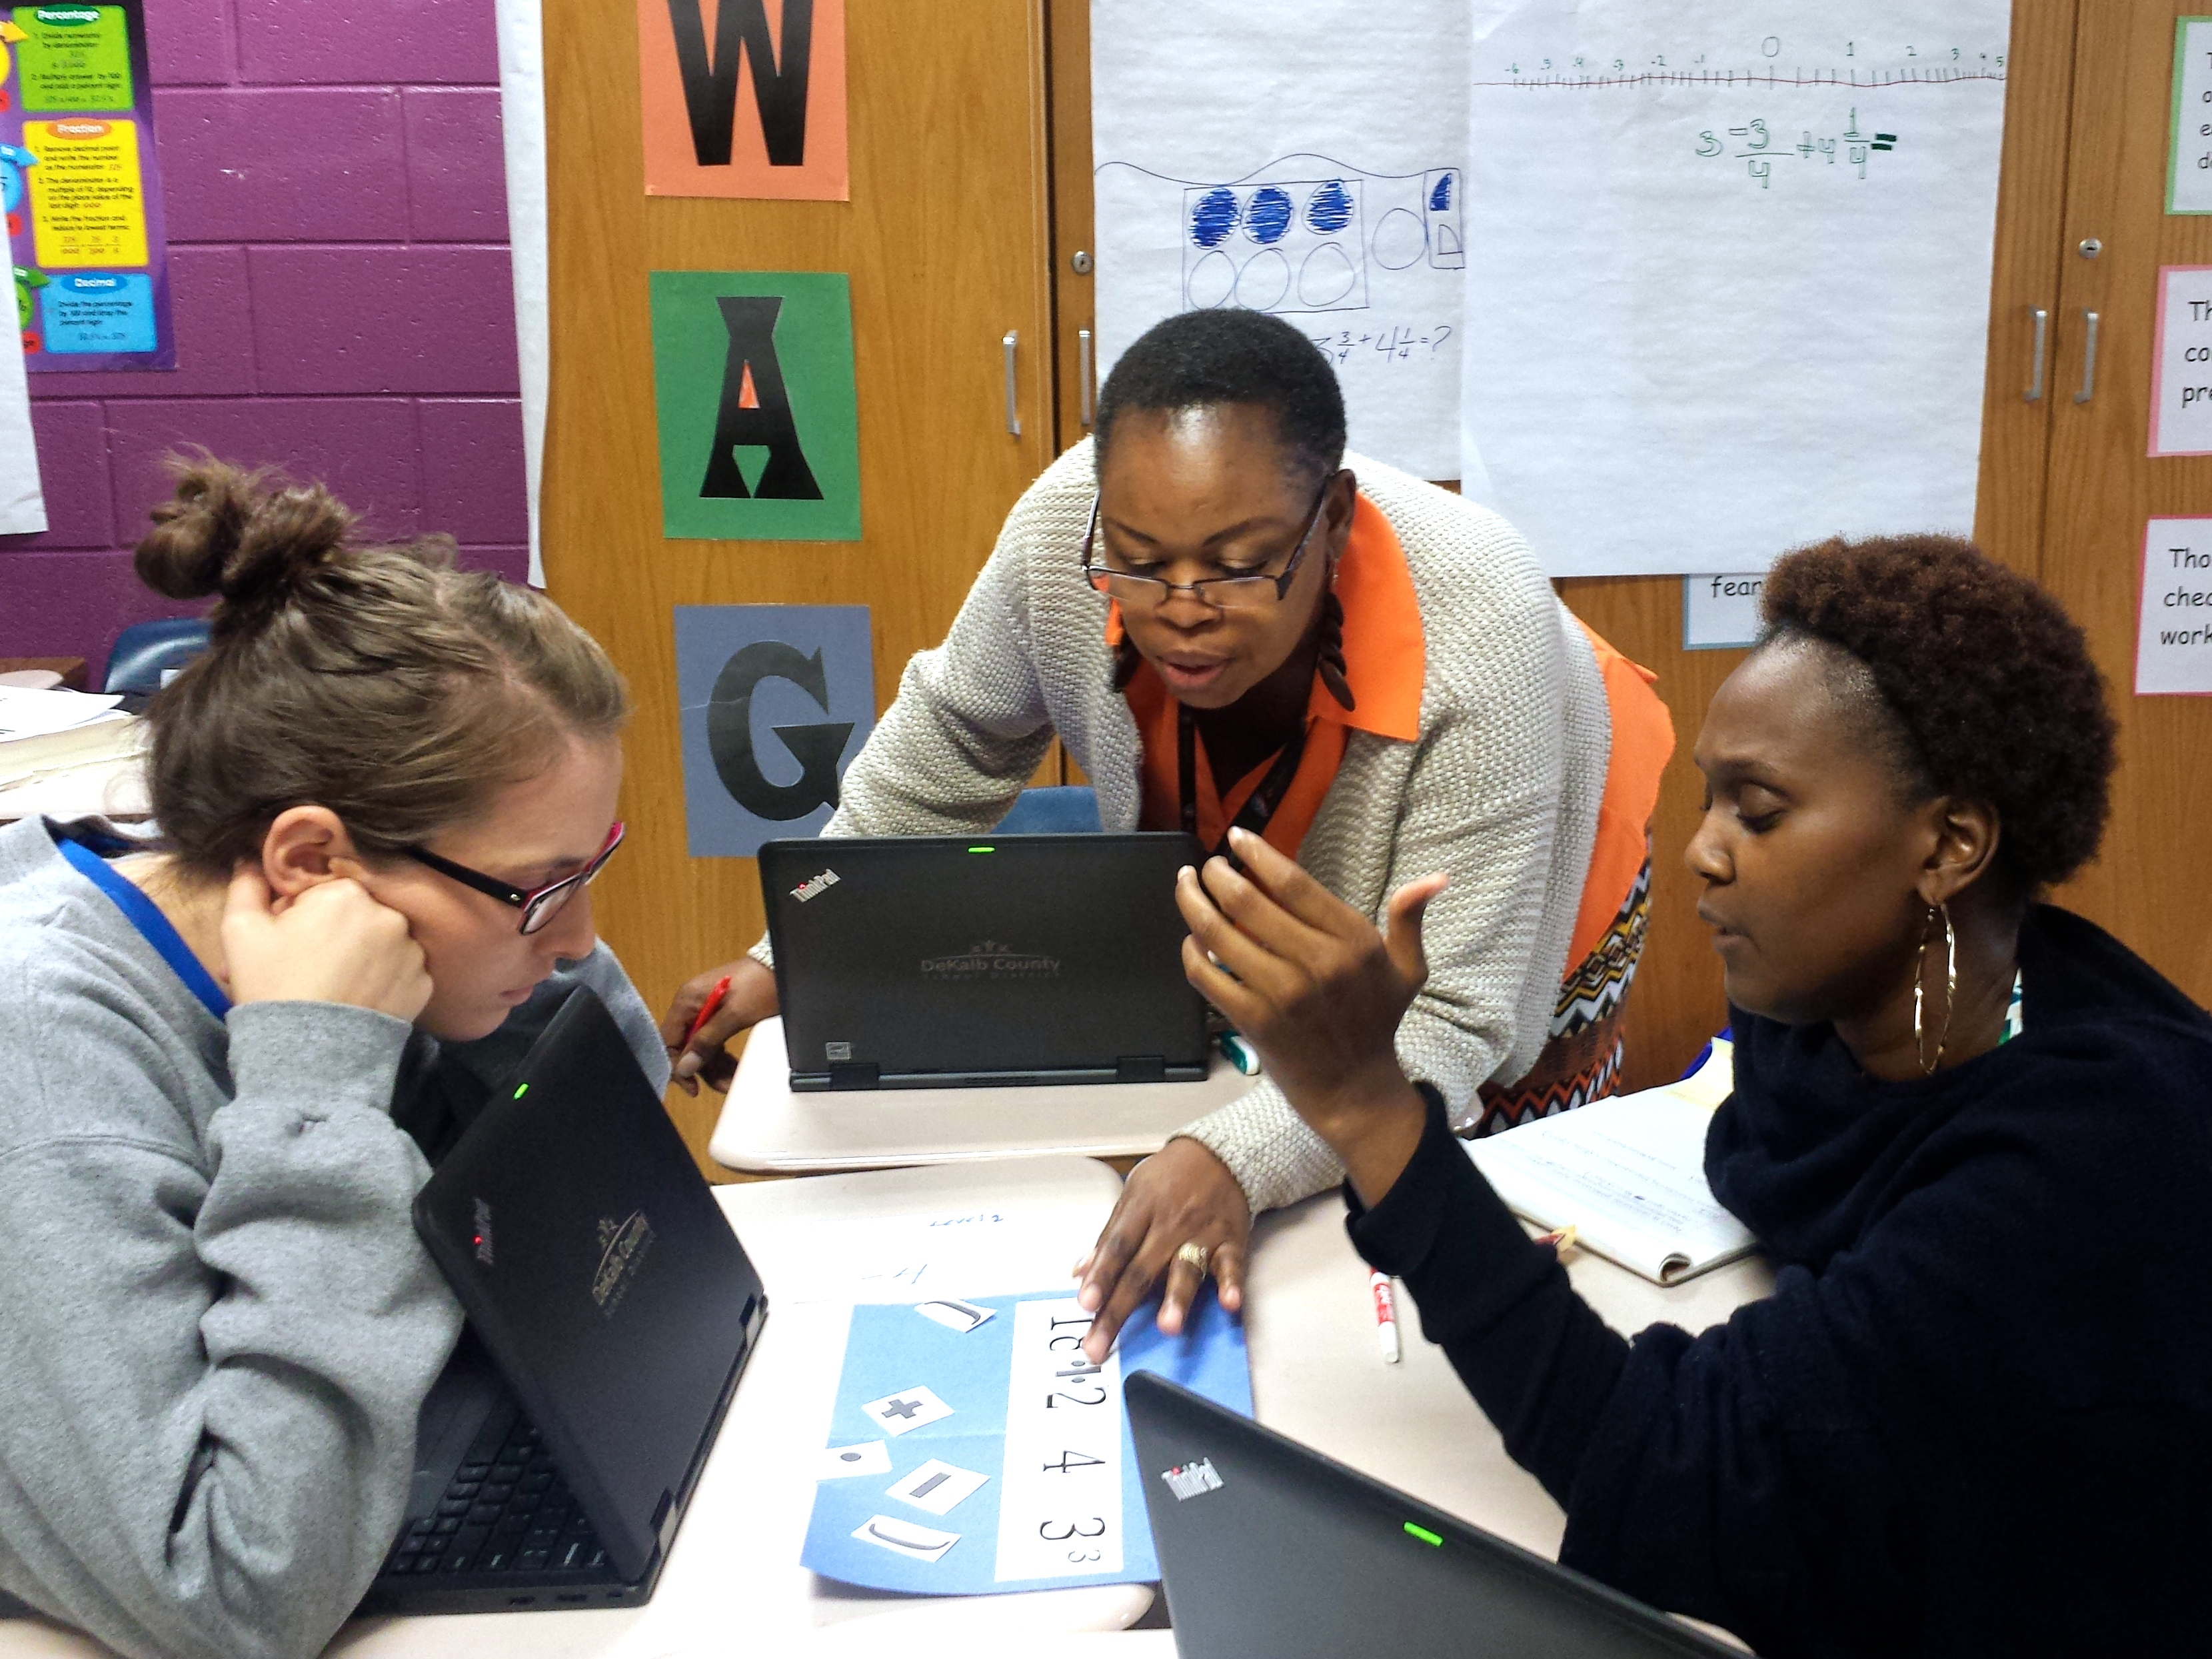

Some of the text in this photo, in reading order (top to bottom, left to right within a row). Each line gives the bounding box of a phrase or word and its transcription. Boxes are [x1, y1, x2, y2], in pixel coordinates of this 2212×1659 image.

[1761, 36, 1779, 57] 0
[1845, 41, 1856, 56] 1
[1905, 45, 1917, 56] 2
[669, 0, 813, 166] W
[2200, 123, 2212, 137] e
[2198, 151, 2212, 169] d
[2187, 300, 2212, 322] Th
[2185, 347, 2212, 363] co
[699, 295, 824, 501] A
[2169, 547, 2212, 568] Tho
[1711, 575, 1761, 598] fear
[2160, 624, 2212, 645] work
[706, 639, 856, 821] G
